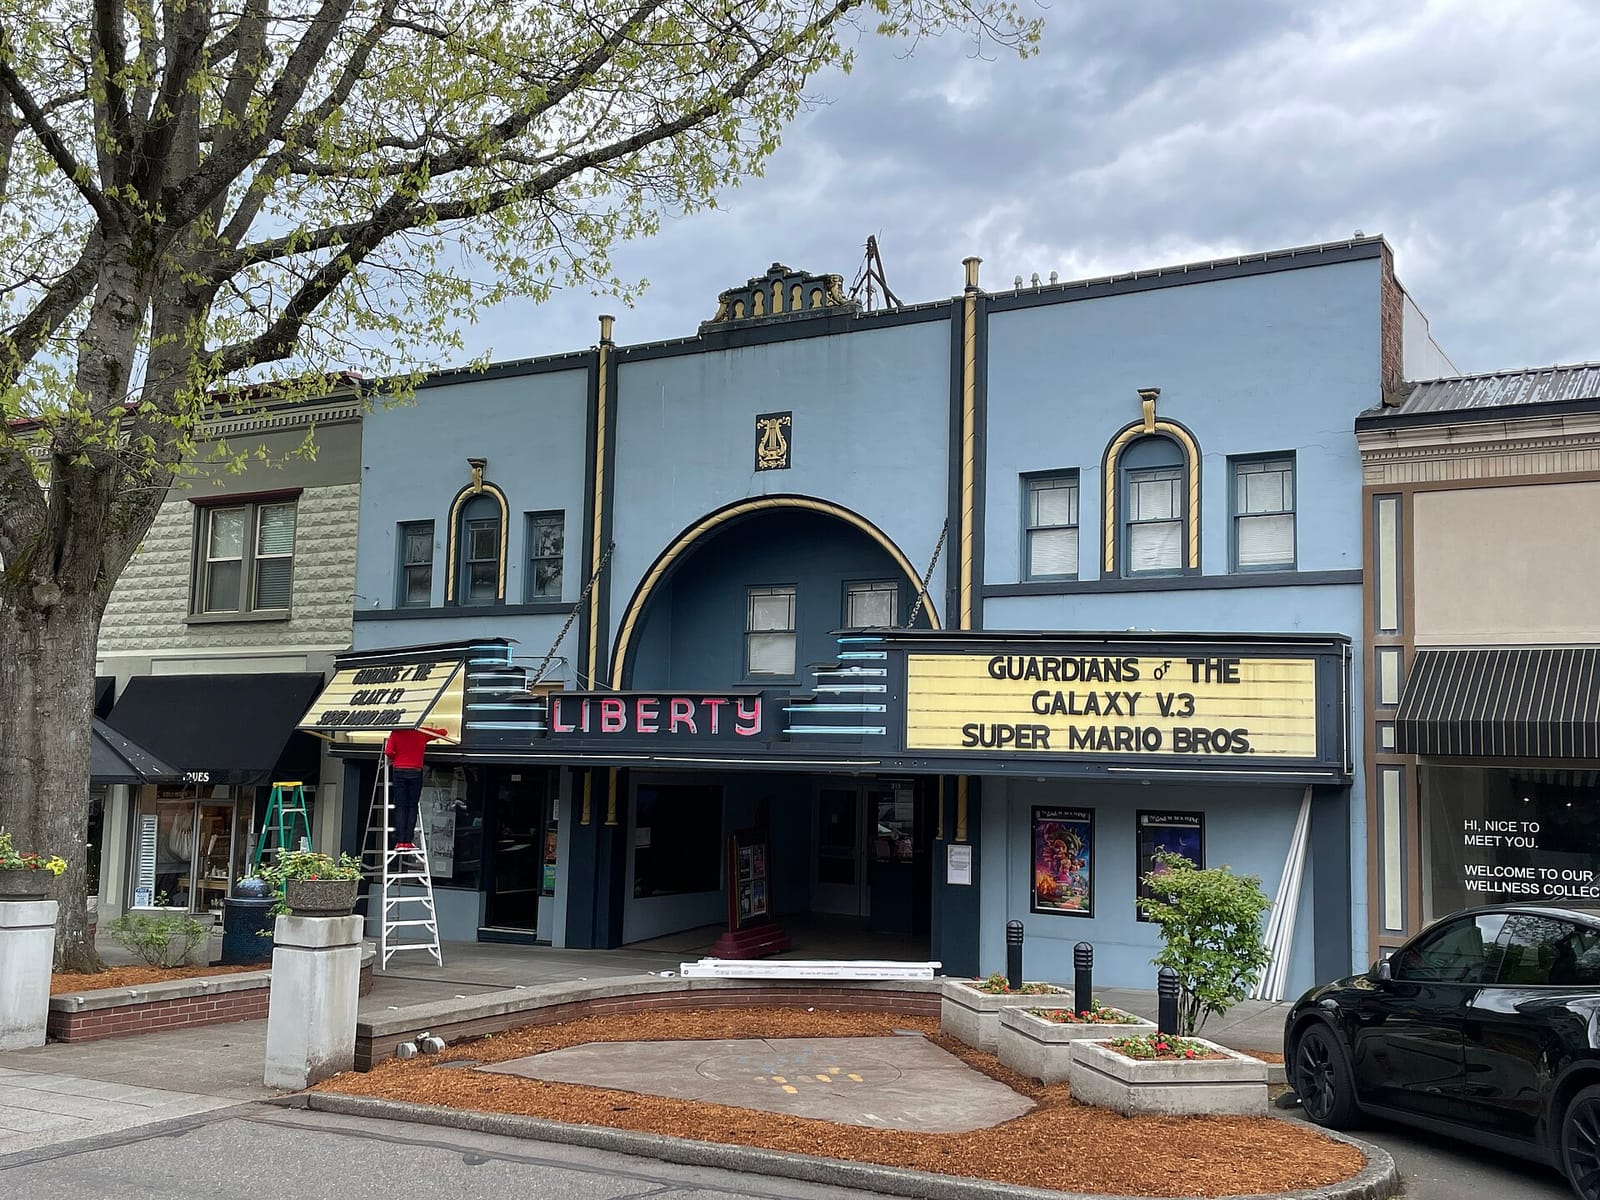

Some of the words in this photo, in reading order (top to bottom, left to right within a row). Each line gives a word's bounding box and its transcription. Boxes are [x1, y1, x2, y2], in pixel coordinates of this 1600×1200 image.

[988, 656, 1140, 682] GUARDIANS
[1187, 658, 1241, 684] THE
[1032, 690, 1142, 717] GALAXY
[1158, 692, 1195, 719] V.3
[553, 697, 762, 736] LIBERTY
[962, 723, 1051, 750] SUPER
[1069, 726, 1163, 752] MARIO
[1173, 727, 1255, 754] BROS.
[1464, 819, 1481, 833] HI,
[1485, 820, 1518, 833] NICE
[1520, 821, 1540, 833] TO
[1464, 835, 1502, 847] MEET
[1505, 836, 1539, 849] YOU.
[1464, 864, 1536, 879] WELCOME
[1538, 868, 1558, 880] TO
[1561, 869, 1594, 882] OUR
[1464, 879, 1540, 894] WELLNESS
[1543, 884, 1600, 898] COLLEC
